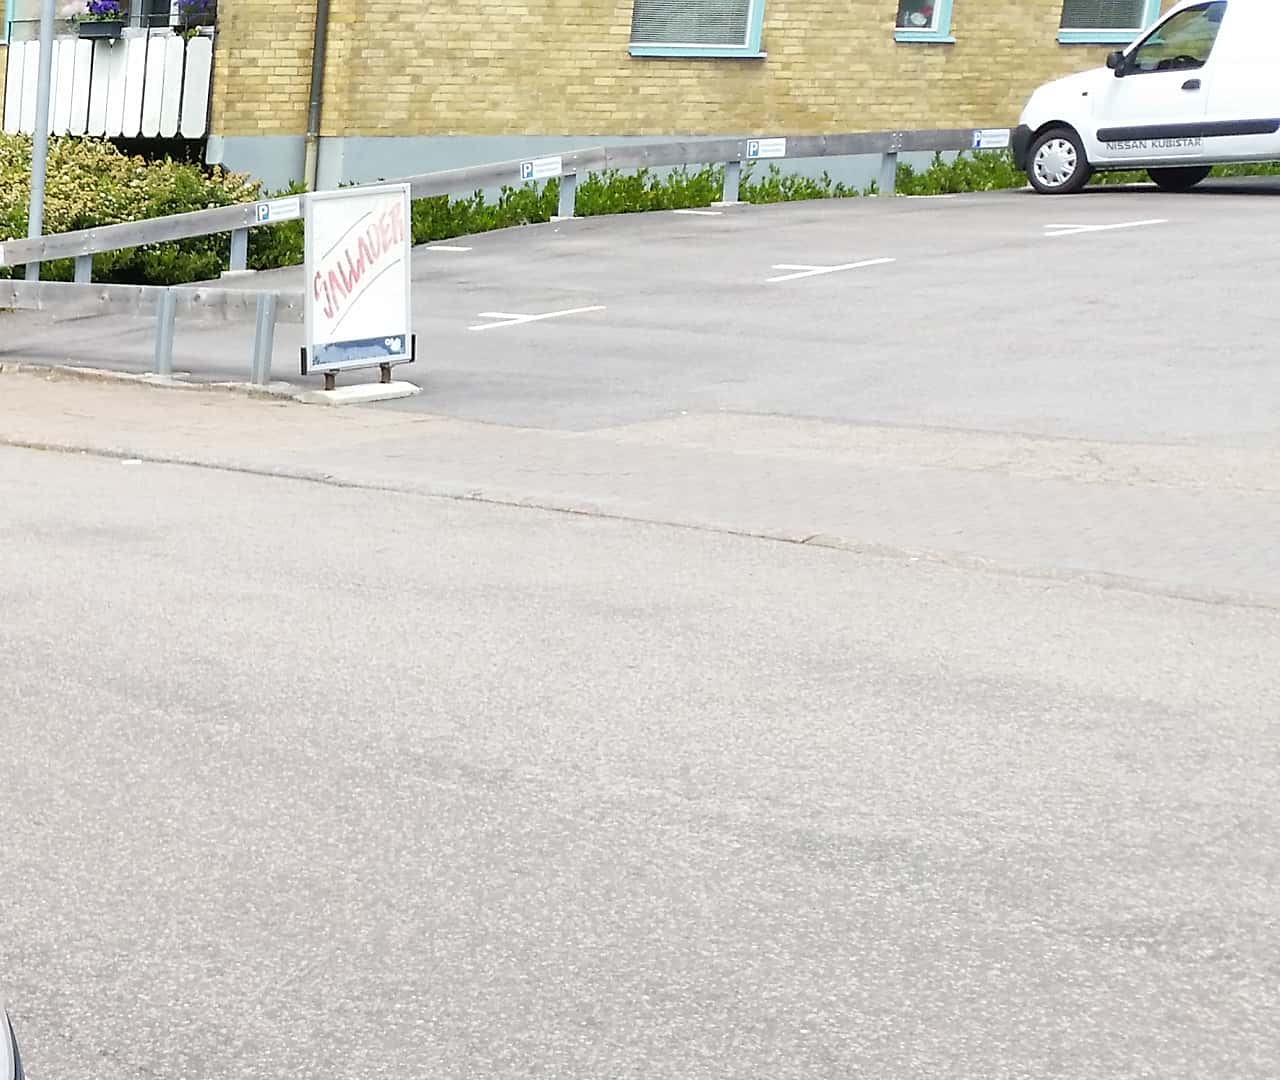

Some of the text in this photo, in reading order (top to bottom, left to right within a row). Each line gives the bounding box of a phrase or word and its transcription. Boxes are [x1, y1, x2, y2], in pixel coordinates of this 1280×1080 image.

[750, 142, 759, 156] P
[1106, 137, 1201, 151] NISSAN KUBISTAR
[524, 163, 532, 178] P
[259, 205, 268, 220] P
